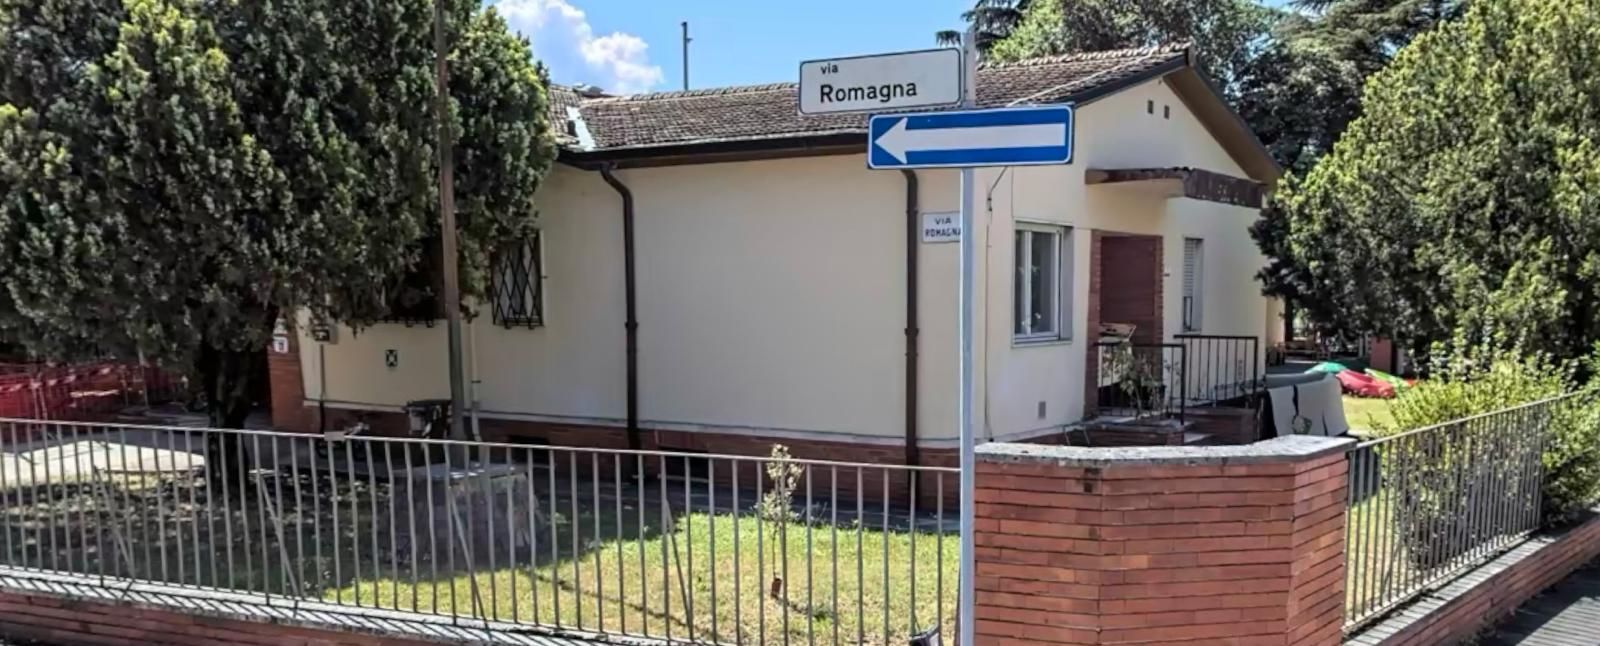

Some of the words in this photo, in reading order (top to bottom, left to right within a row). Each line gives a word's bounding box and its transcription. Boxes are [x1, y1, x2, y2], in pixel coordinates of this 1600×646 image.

[820, 63, 839, 75] via
[820, 82, 917, 103] Romagna
[935, 217, 952, 225] VIA
